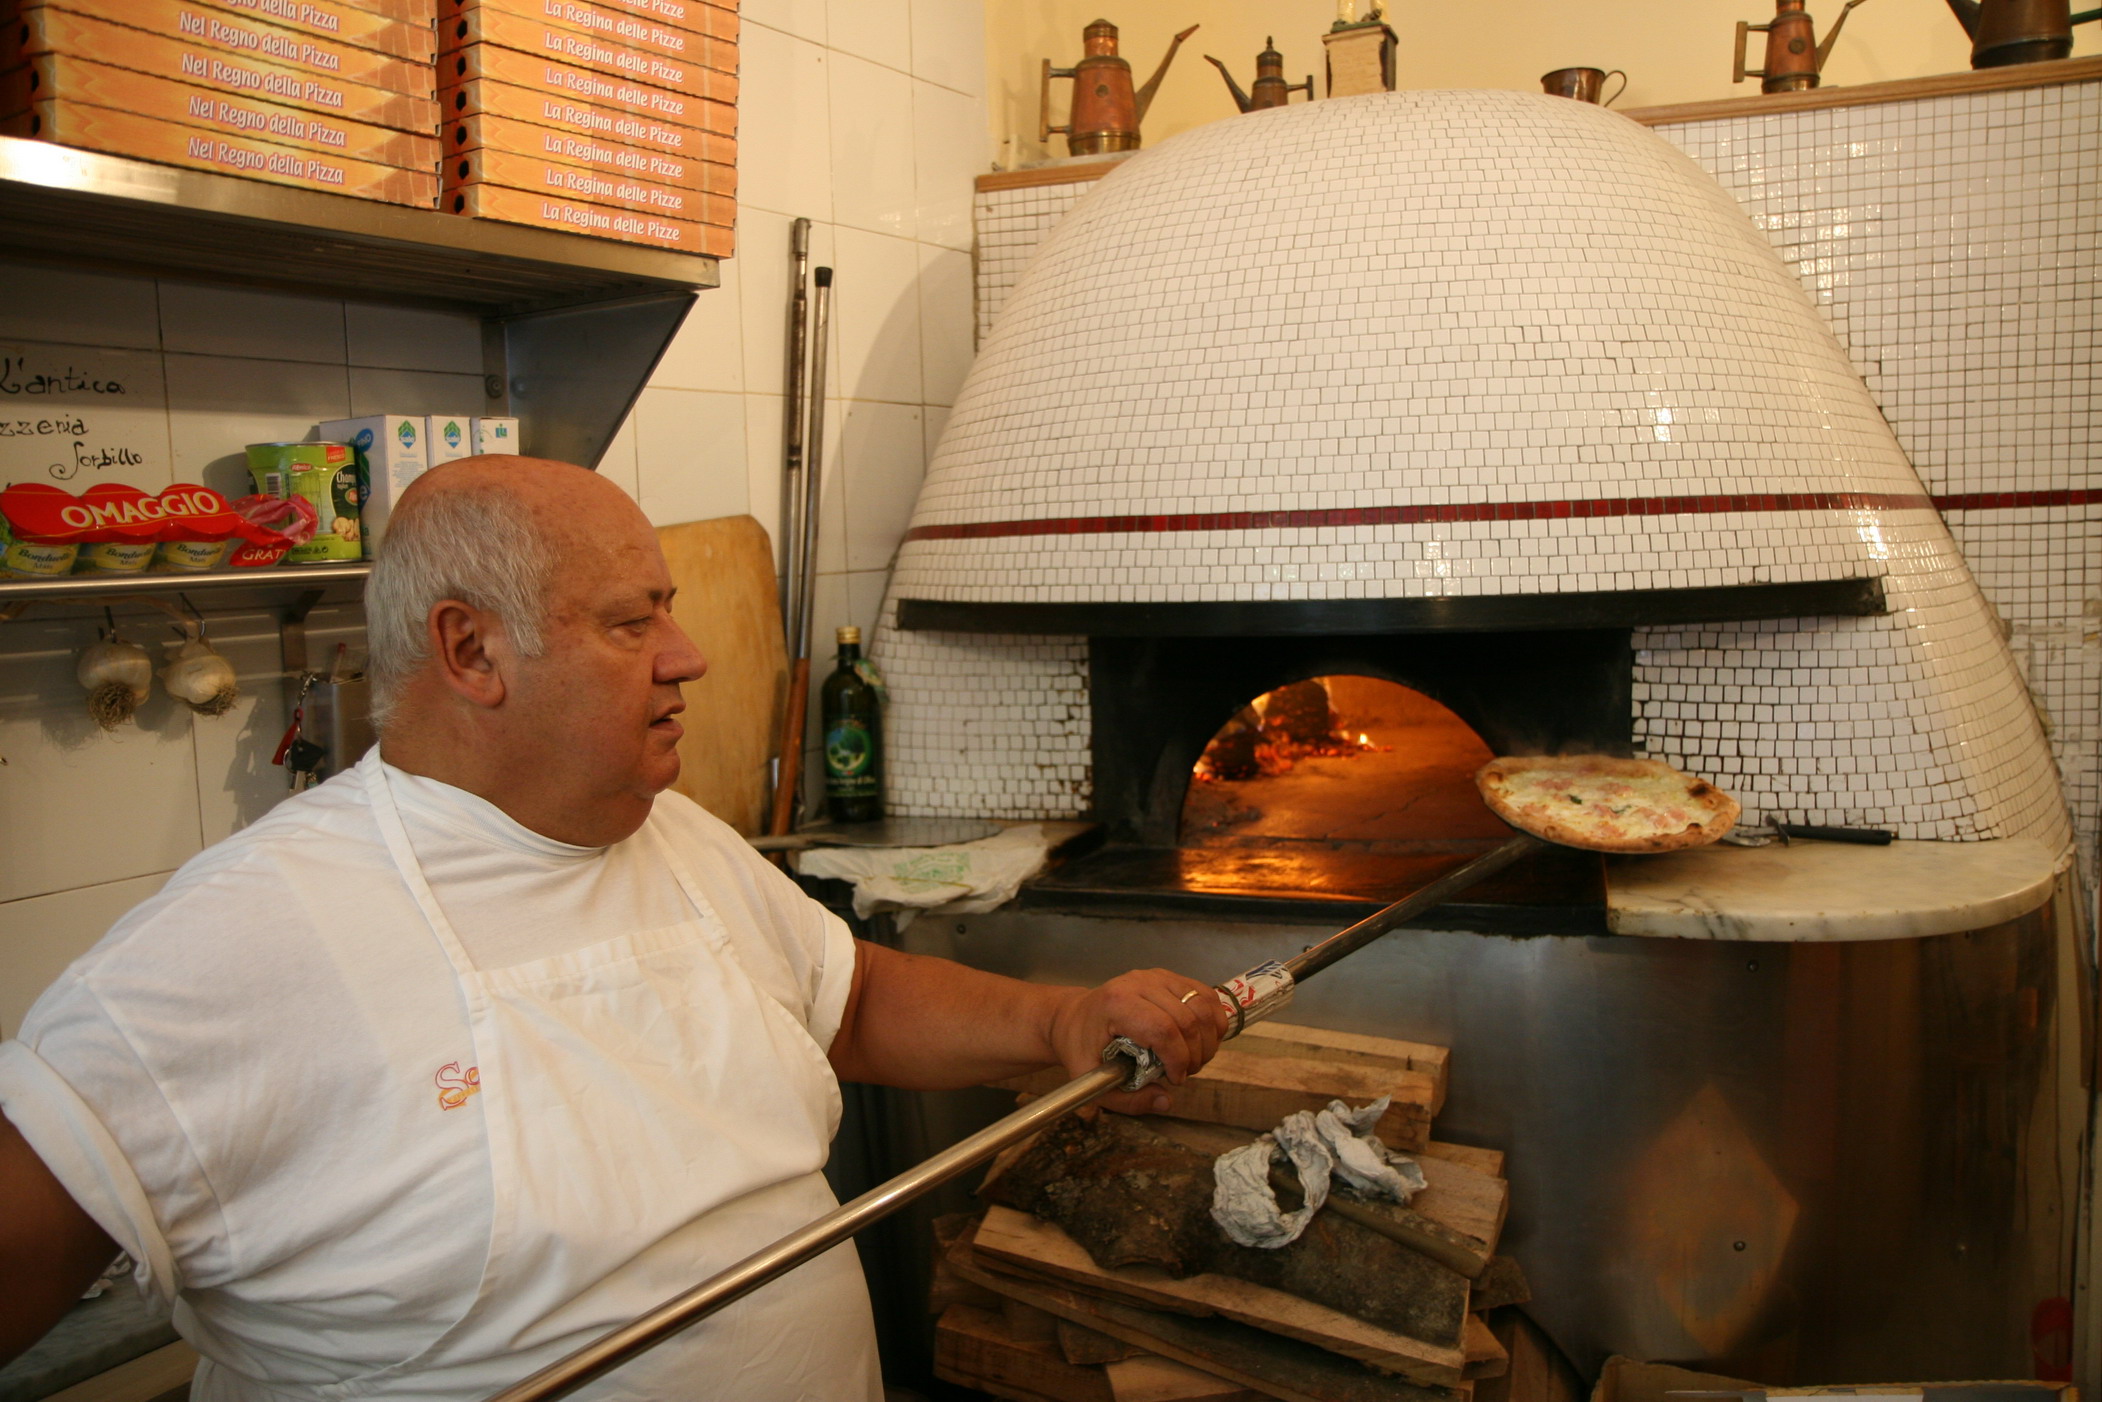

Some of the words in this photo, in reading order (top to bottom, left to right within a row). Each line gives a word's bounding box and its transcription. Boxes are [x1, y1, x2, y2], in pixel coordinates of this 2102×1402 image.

[180, 11, 205, 35] Nel
[211, 19, 258, 48] Regno
[262, 35, 298, 59] della
[302, 44, 339, 69] Pizza
[301, 5, 338, 30] Pizza
[545, 0, 562, 17] La
[567, 5, 613, 31] Regina
[617, 21, 648, 41] delle
[652, 29, 684, 50] Pizze
[182, 53, 207, 76] Nel
[213, 61, 260, 88] Regno
[265, 74, 300, 98] della
[305, 82, 343, 107] Pizza
[545, 32, 562, 50] La
[567, 38, 613, 64] Regina
[617, 53, 648, 73] delle
[651, 62, 683, 83] Pizze
[546, 68, 562, 86] La
[568, 73, 613, 98] Regina
[617, 87, 648, 107] delle
[652, 95, 684, 115] Pizze
[189, 96, 214, 118] Nel
[219, 103, 265, 129] Regno
[270, 115, 304, 138] della
[309, 122, 345, 146] Pizza
[544, 102, 561, 120] La
[566, 107, 612, 131] Regina
[615, 120, 646, 139] delle
[650, 126, 682, 147] Pizze
[189, 137, 214, 159] Nel
[218, 143, 265, 169] Regno
[269, 154, 303, 176] della
[307, 161, 343, 184] Pizza
[545, 135, 562, 153] La
[566, 140, 612, 164] Regina
[616, 152, 647, 171] delle
[650, 158, 683, 178] Pizze
[547, 169, 563, 187] La
[567, 173, 613, 196] Regina
[617, 184, 647, 203] delle
[651, 190, 682, 209] Pizze
[543, 203, 559, 220] La
[564, 207, 610, 229] Regina
[614, 217, 644, 235] delle
[648, 222, 680, 241] Pizze
[0, 357, 126, 395] L'antica
[61, 491, 220, 528] OMAGGIO
[242, 548, 286, 561] GRAT
